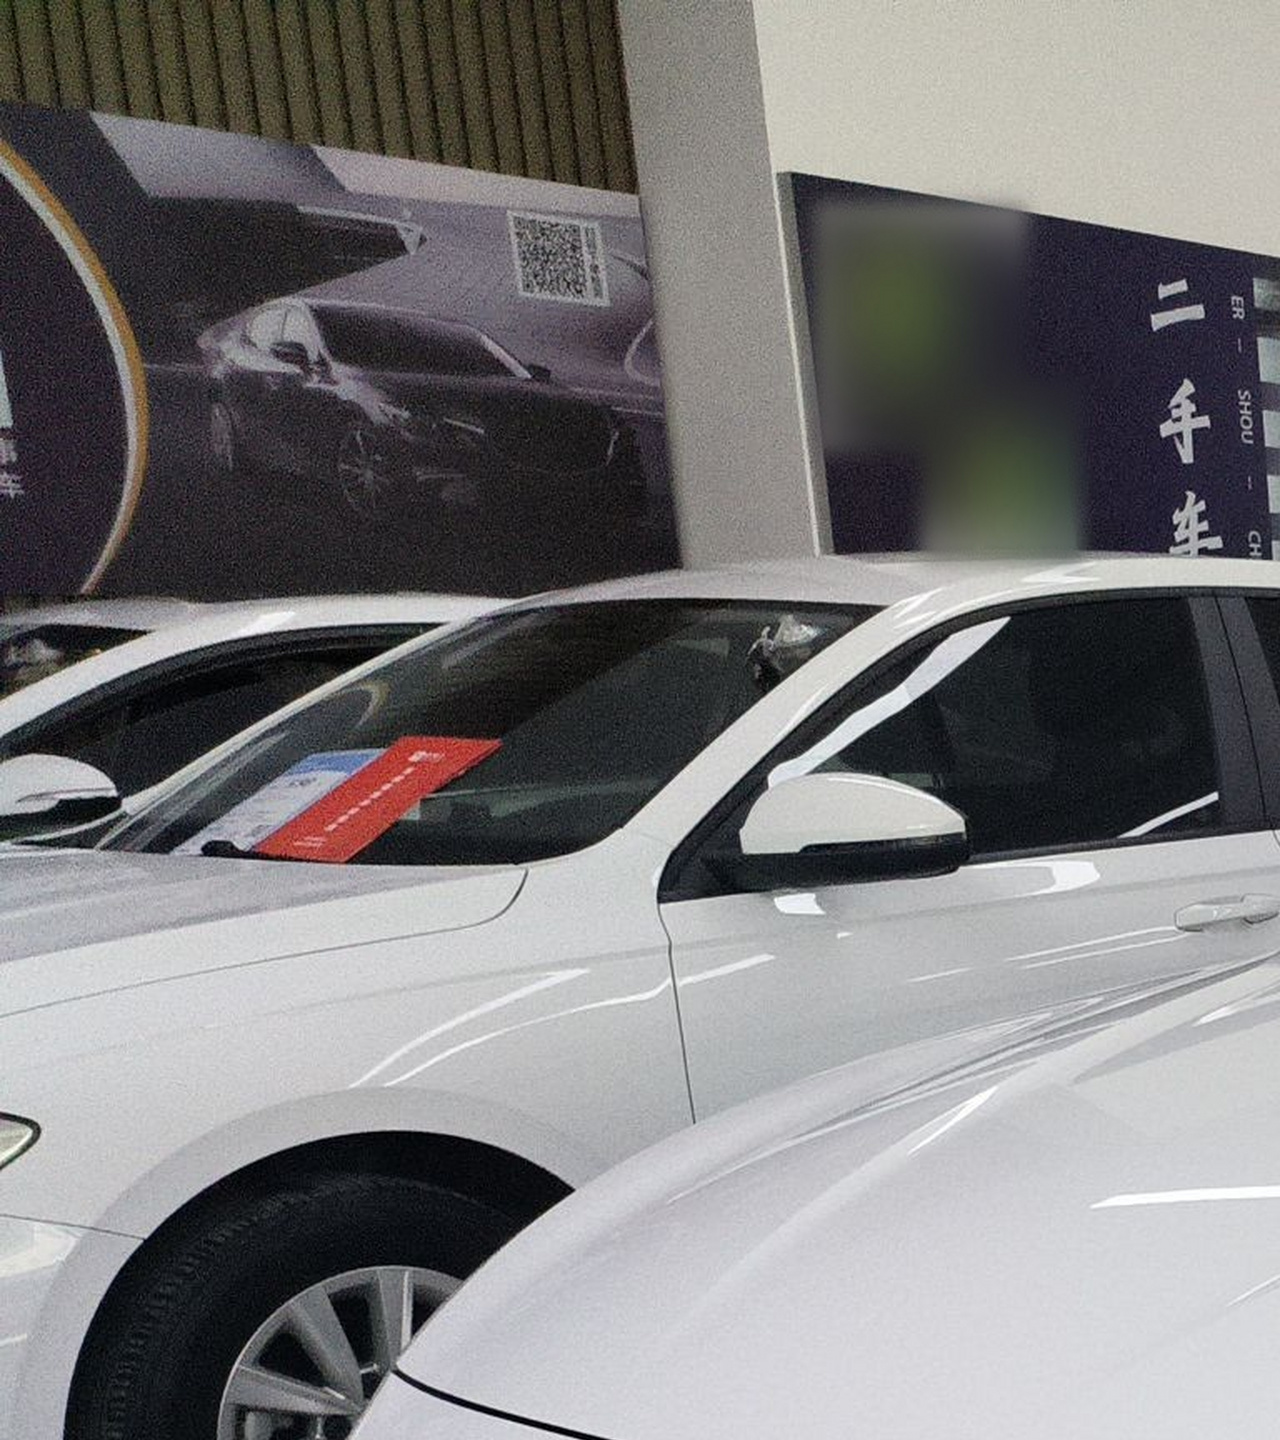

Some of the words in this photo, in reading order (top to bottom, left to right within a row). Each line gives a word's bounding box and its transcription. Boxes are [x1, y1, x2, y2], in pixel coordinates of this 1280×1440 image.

[1230, 294, 1245, 320] ER
[1150, 278, 1223, 557] 二手车
[1237, 389, 1254, 444] SHOU
